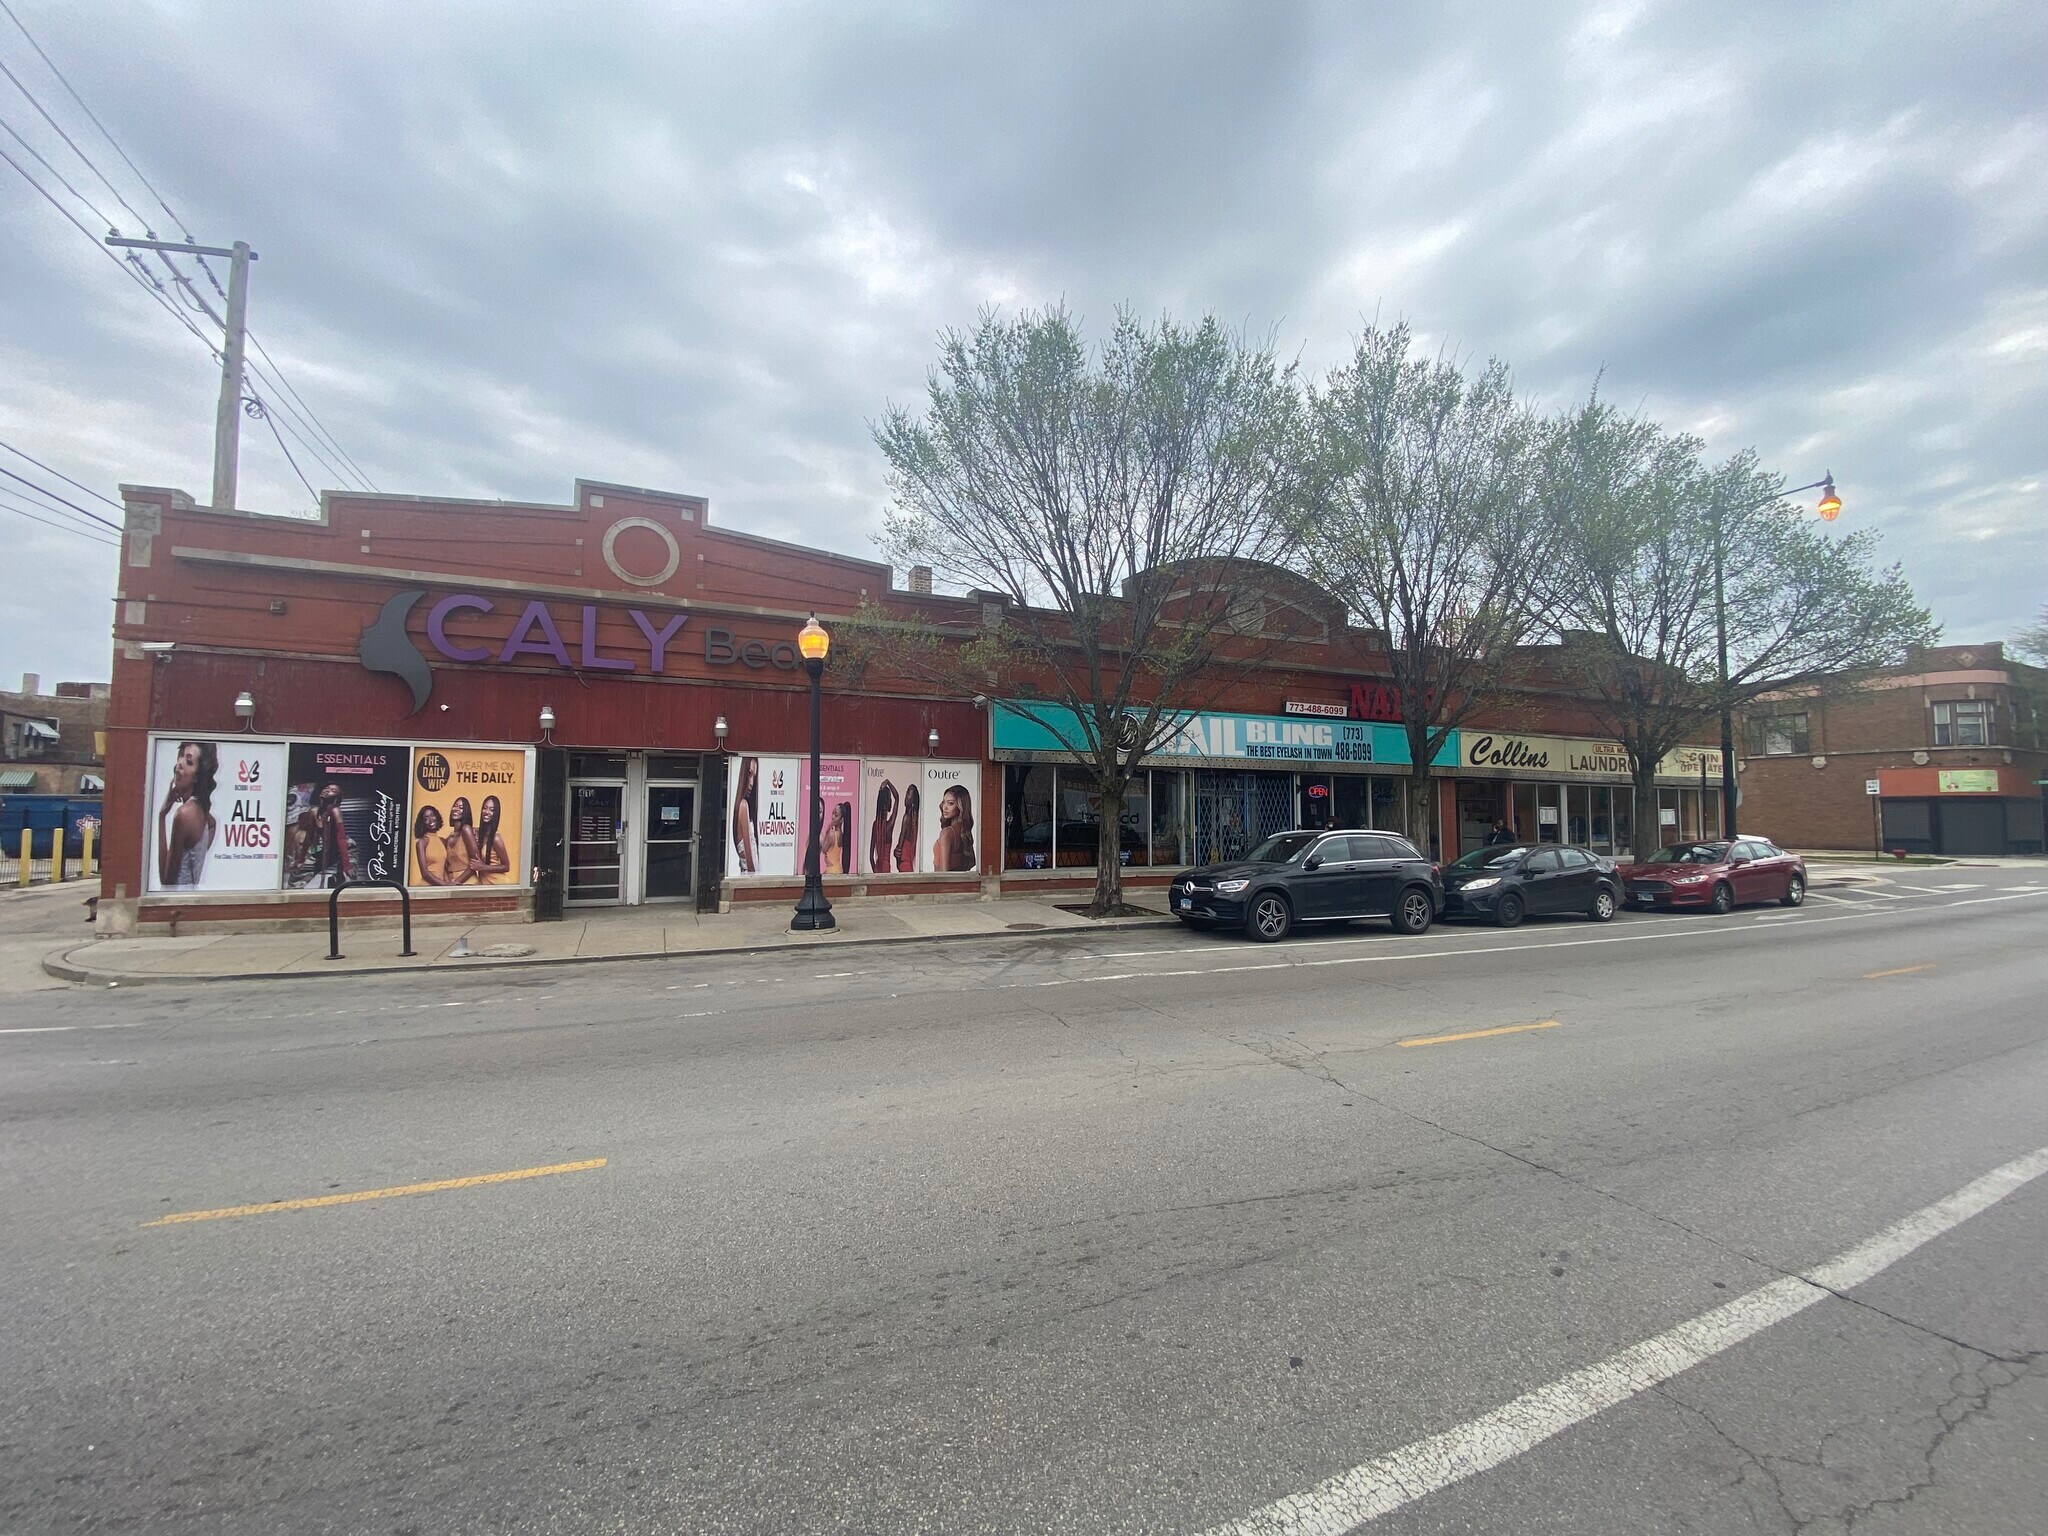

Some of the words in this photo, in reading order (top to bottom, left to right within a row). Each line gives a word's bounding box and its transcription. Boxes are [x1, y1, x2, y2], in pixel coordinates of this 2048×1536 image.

[427, 594, 689, 672] CALY
[1289, 703, 1344, 715] 773-488-6099
[1246, 721, 1332, 746] BLING
[1343, 726, 1363, 741] (773)
[1246, 745, 1259, 757] THE
[1260, 745, 1275, 757] BEST
[1277, 746, 1302, 758] EYELASH
[1304, 748, 1312, 759] IN
[1313, 748, 1332, 759] TOWN
[1335, 742, 1372, 761] 488-6099
[1469, 736, 1550, 768] Collins
[1595, 745, 1615, 754] ULTRA
[316, 753, 387, 765] ESSENTIALS
[424, 755, 440, 766] THE
[1570, 754, 1664, 774] LAUNDRT
[422, 766, 446, 778] DAILY
[456, 761, 483, 770] WEAR
[485, 762, 498, 771] ME
[500, 762, 515, 772] ON
[820, 764, 844, 772] SENTIALS
[1680, 763, 1723, 773] OPEATE
[456, 771, 478, 783] THE
[428, 778, 446, 790] WIG
[1310, 787, 1328, 797] OPEN
[231, 799, 266, 822] ALL
[768, 801, 786, 820] ALL
[759, 821, 795, 836] WEAVINGS
[225, 824, 270, 847] WIGS
